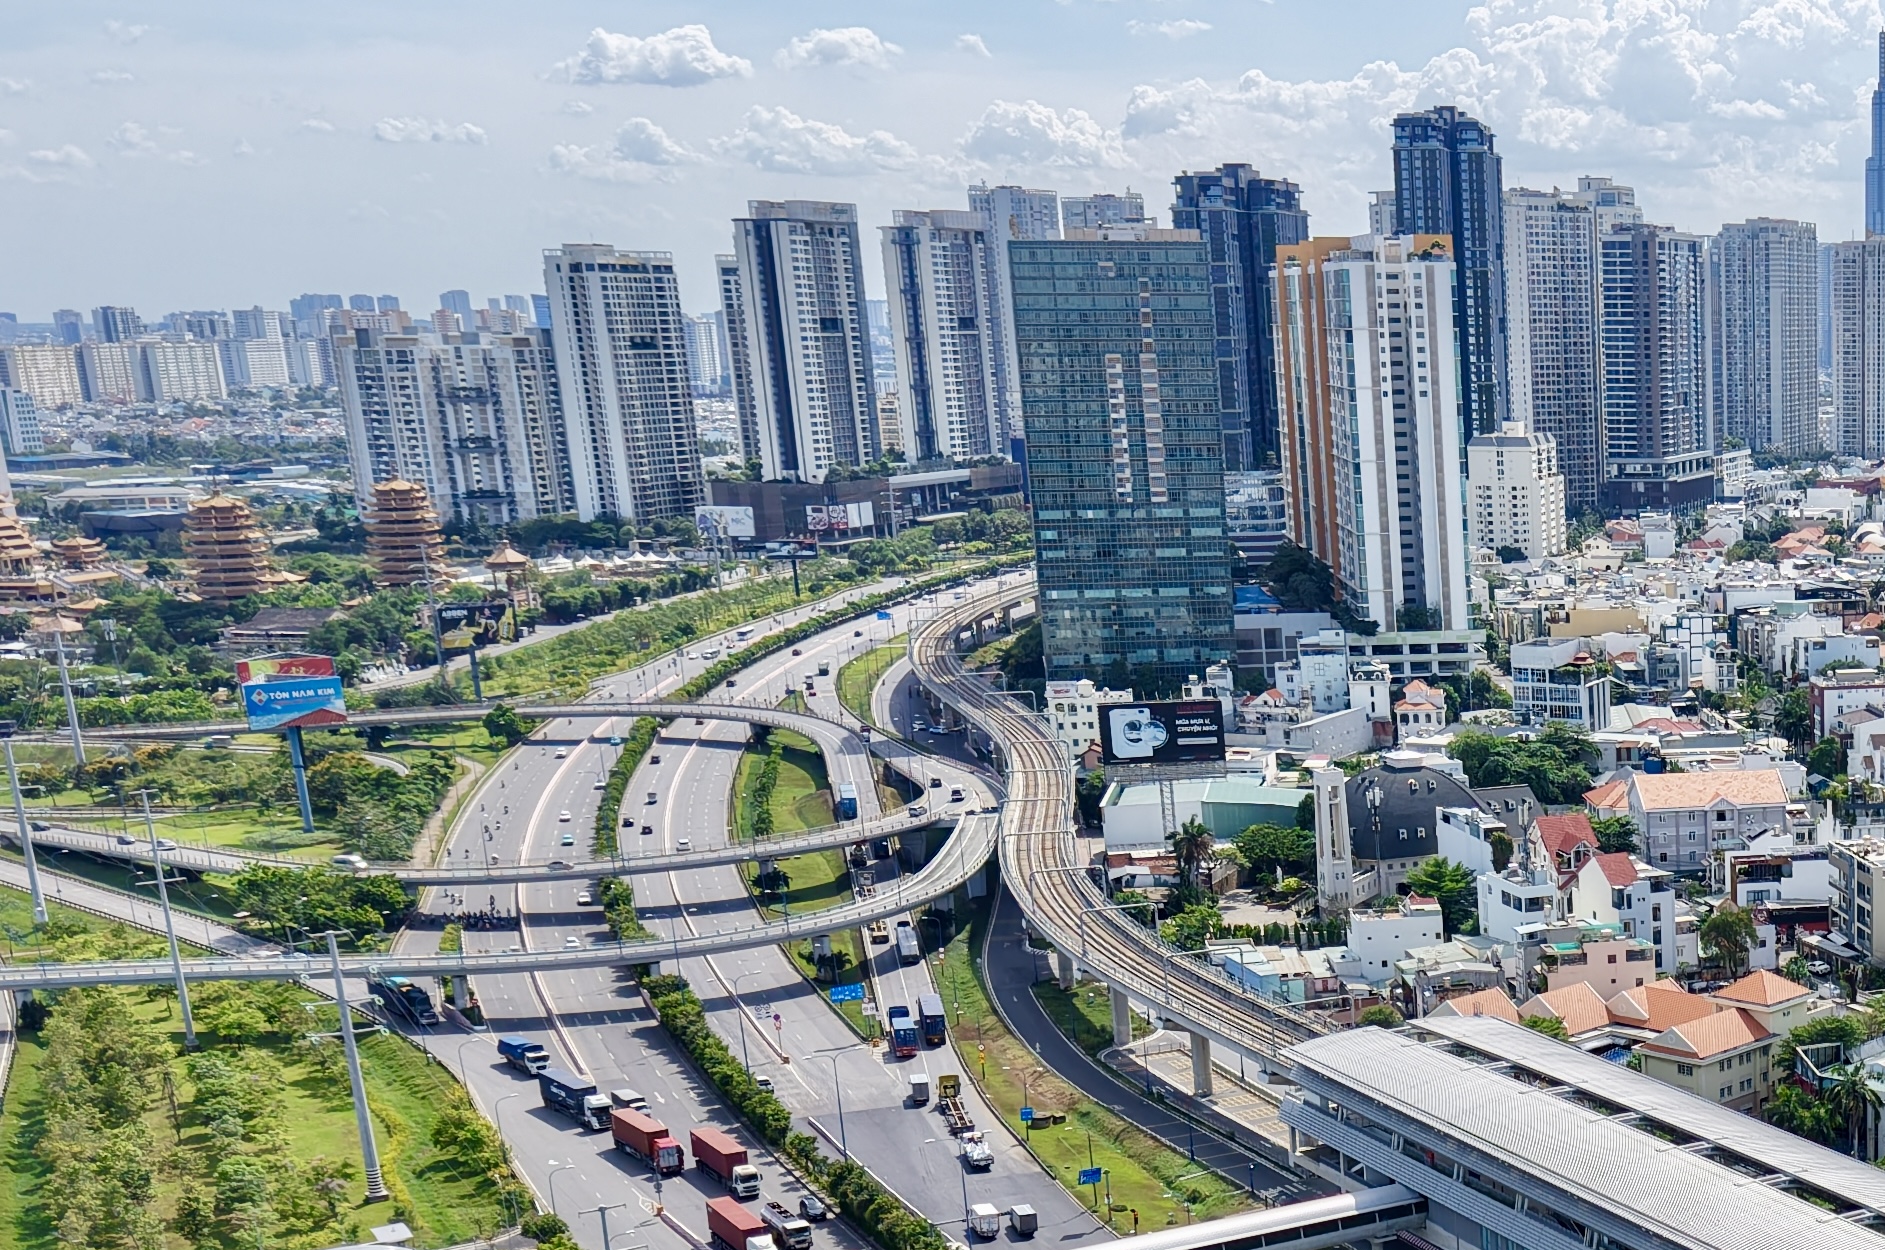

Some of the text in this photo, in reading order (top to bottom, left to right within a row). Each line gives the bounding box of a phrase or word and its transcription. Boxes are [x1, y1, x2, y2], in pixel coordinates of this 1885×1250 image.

[269, 687, 336, 700] TÔN NAM KIM
